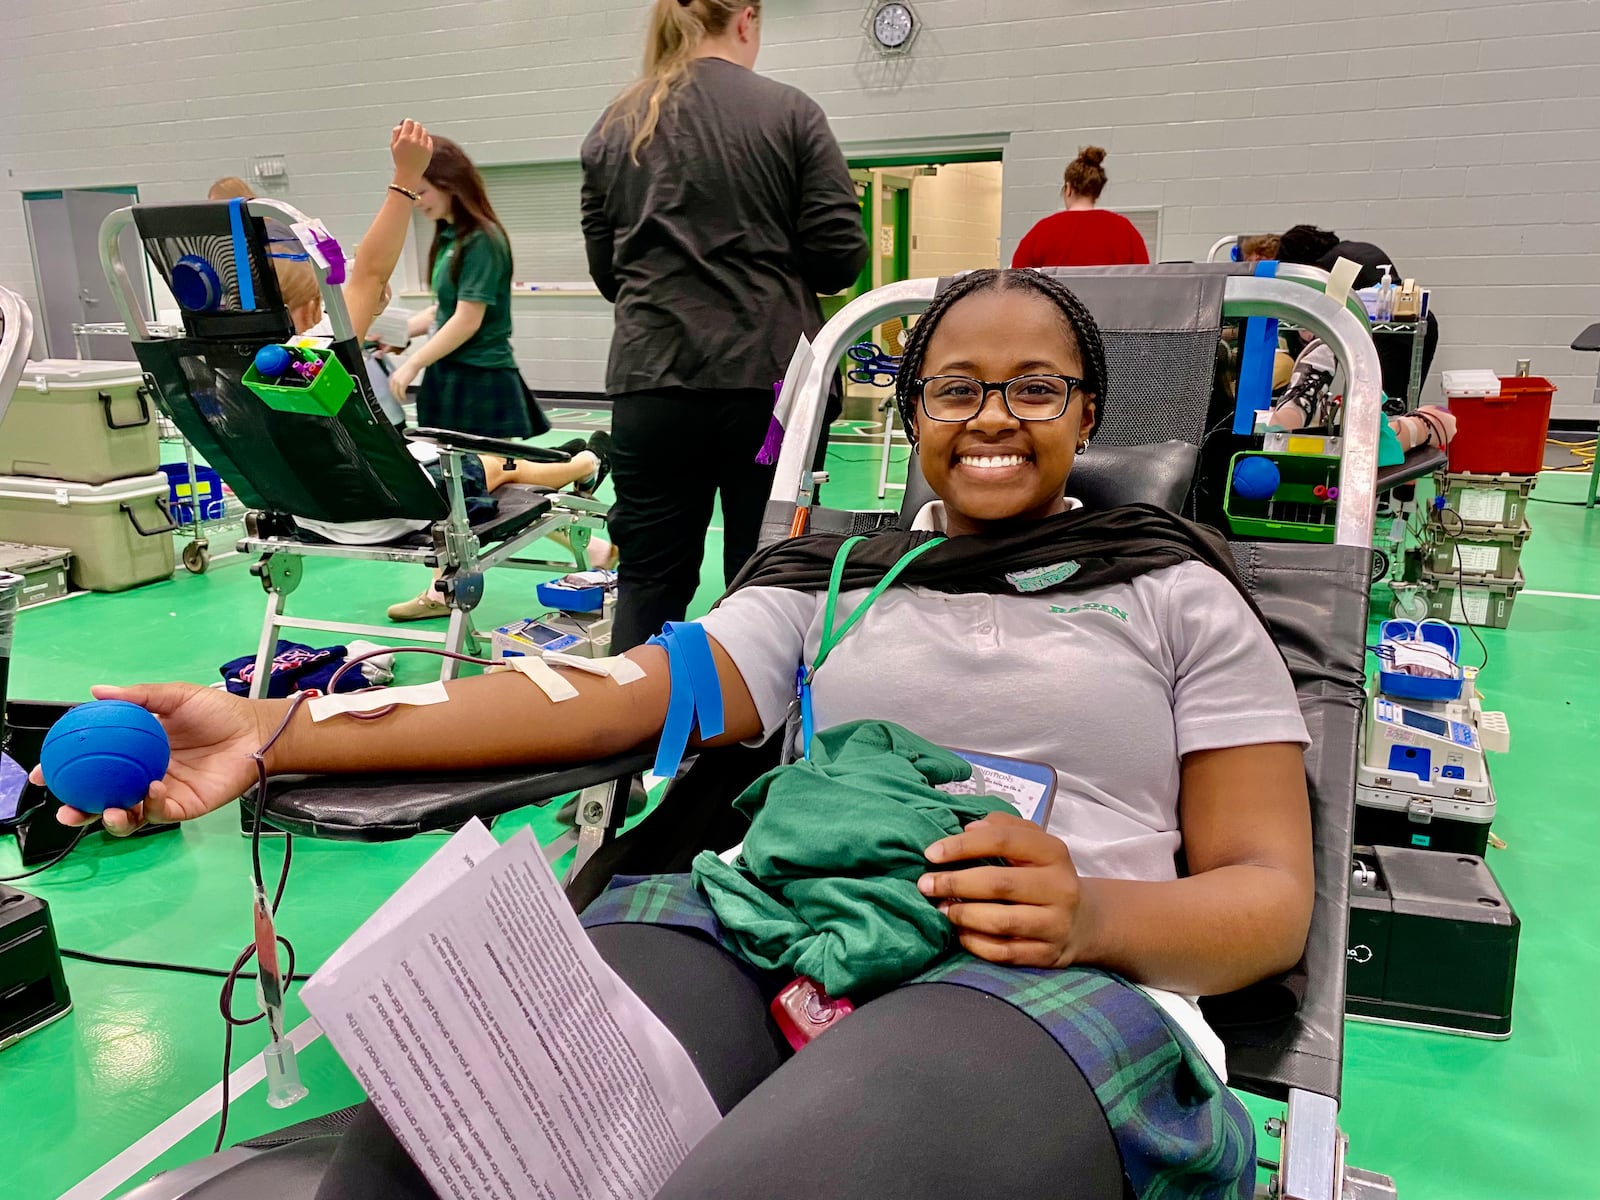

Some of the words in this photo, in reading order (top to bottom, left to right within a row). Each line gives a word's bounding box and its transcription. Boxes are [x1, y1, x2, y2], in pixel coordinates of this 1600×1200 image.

[429, 932, 438, 943] for
[435, 943, 447, 958] ask
[442, 936, 458, 960] blood
[400, 960, 413, 976] and
[444, 959, 457, 974] and
[460, 966, 468, 976] to
[506, 955, 520, 978] hours.
[381, 977, 394, 997] nor-
[411, 977, 425, 996] over
[453, 975, 471, 1000] Versiti
[465, 977, 482, 1000] speak
[517, 978, 526, 990] 24
[369, 992, 379, 1002] of
[390, 997, 403, 1013] Eat
[421, 996, 435, 1011] pull
[480, 1000, 488, 1010] to
[510, 988, 523, 1006] kept
[523, 989, 536, 1005] next
[345, 1011, 357, 1028] the
[376, 1002, 389, 1020] lots
[468, 1000, 489, 1030] contact
[521, 1006, 530, 1017] be
[533, 1005, 543, 1019] the
[400, 1011, 417, 1035] meal.
[431, 1010, 450, 1039] driving
[527, 1017, 537, 1030] will
[541, 1018, 547, 1026] in
[353, 1027, 369, 1045] until
[386, 1018, 409, 1053] drinking
[492, 1022, 509, 1043] press
[419, 1042, 434, 1064] have
[448, 1039, 459, 1053] are
[487, 1030, 504, 1058] Please
[535, 1030, 563, 1076] Information
[364, 1045, 382, 1069] head
[456, 1053, 470, 1069] you
[505, 1043, 520, 1066] hours
[545, 1026, 584, 1091] infection/sickness
[380, 1068, 396, 1088] your
[407, 1051, 432, 1092] donation,
[431, 1063, 445, 1080] you
[503, 1057, 524, 1090] concern.
[440, 1079, 454, 1097] until
[470, 1076, 486, 1099] head.
[518, 1066, 539, 1100] business
[392, 1088, 406, 1107] over
[429, 1091, 446, 1111] your
[452, 1098, 460, 1107] or
[521, 1090, 535, 1110] main
[561, 1077, 586, 1118] transfused.
[581, 1091, 588, 1099] of
[403, 1107, 417, 1125] arm
[483, 1099, 499, 1118] your
[533, 1111, 542, 1124] our
[537, 1099, 550, 1118] after
[586, 1099, 598, 1118] type
[441, 1111, 456, 1131] after
[457, 1107, 474, 1132] hours
[583, 1118, 591, 1129] be
[595, 1117, 605, 1132] any
[414, 1126, 431, 1145] your
[494, 1117, 512, 1143] above
[540, 1124, 557, 1152] always
[552, 1127, 567, 1149] apply
[588, 1127, 599, 1142] not
[451, 1131, 468, 1153] tired
[470, 1131, 492, 1160] several
[509, 1142, 518, 1155] up
[426, 1145, 442, 1166] raise
[448, 1153, 462, 1173] arm.
[463, 1151, 478, 1169] feel
[514, 1154, 528, 1173] feet
[555, 1152, 561, 1160] is
[595, 1142, 613, 1166] should
[608, 1140, 635, 1178] symptoms
[437, 1166, 452, 1183] and
[475, 1167, 490, 1184] you
[489, 1161, 500, 1174] for
[559, 1159, 580, 1192] patients
[564, 1148, 585, 1185] following
[459, 1173, 475, 1192] your
[483, 1184, 492, 1192] If
[526, 1173, 540, 1191] your
[582, 1184, 592, 1199] the
